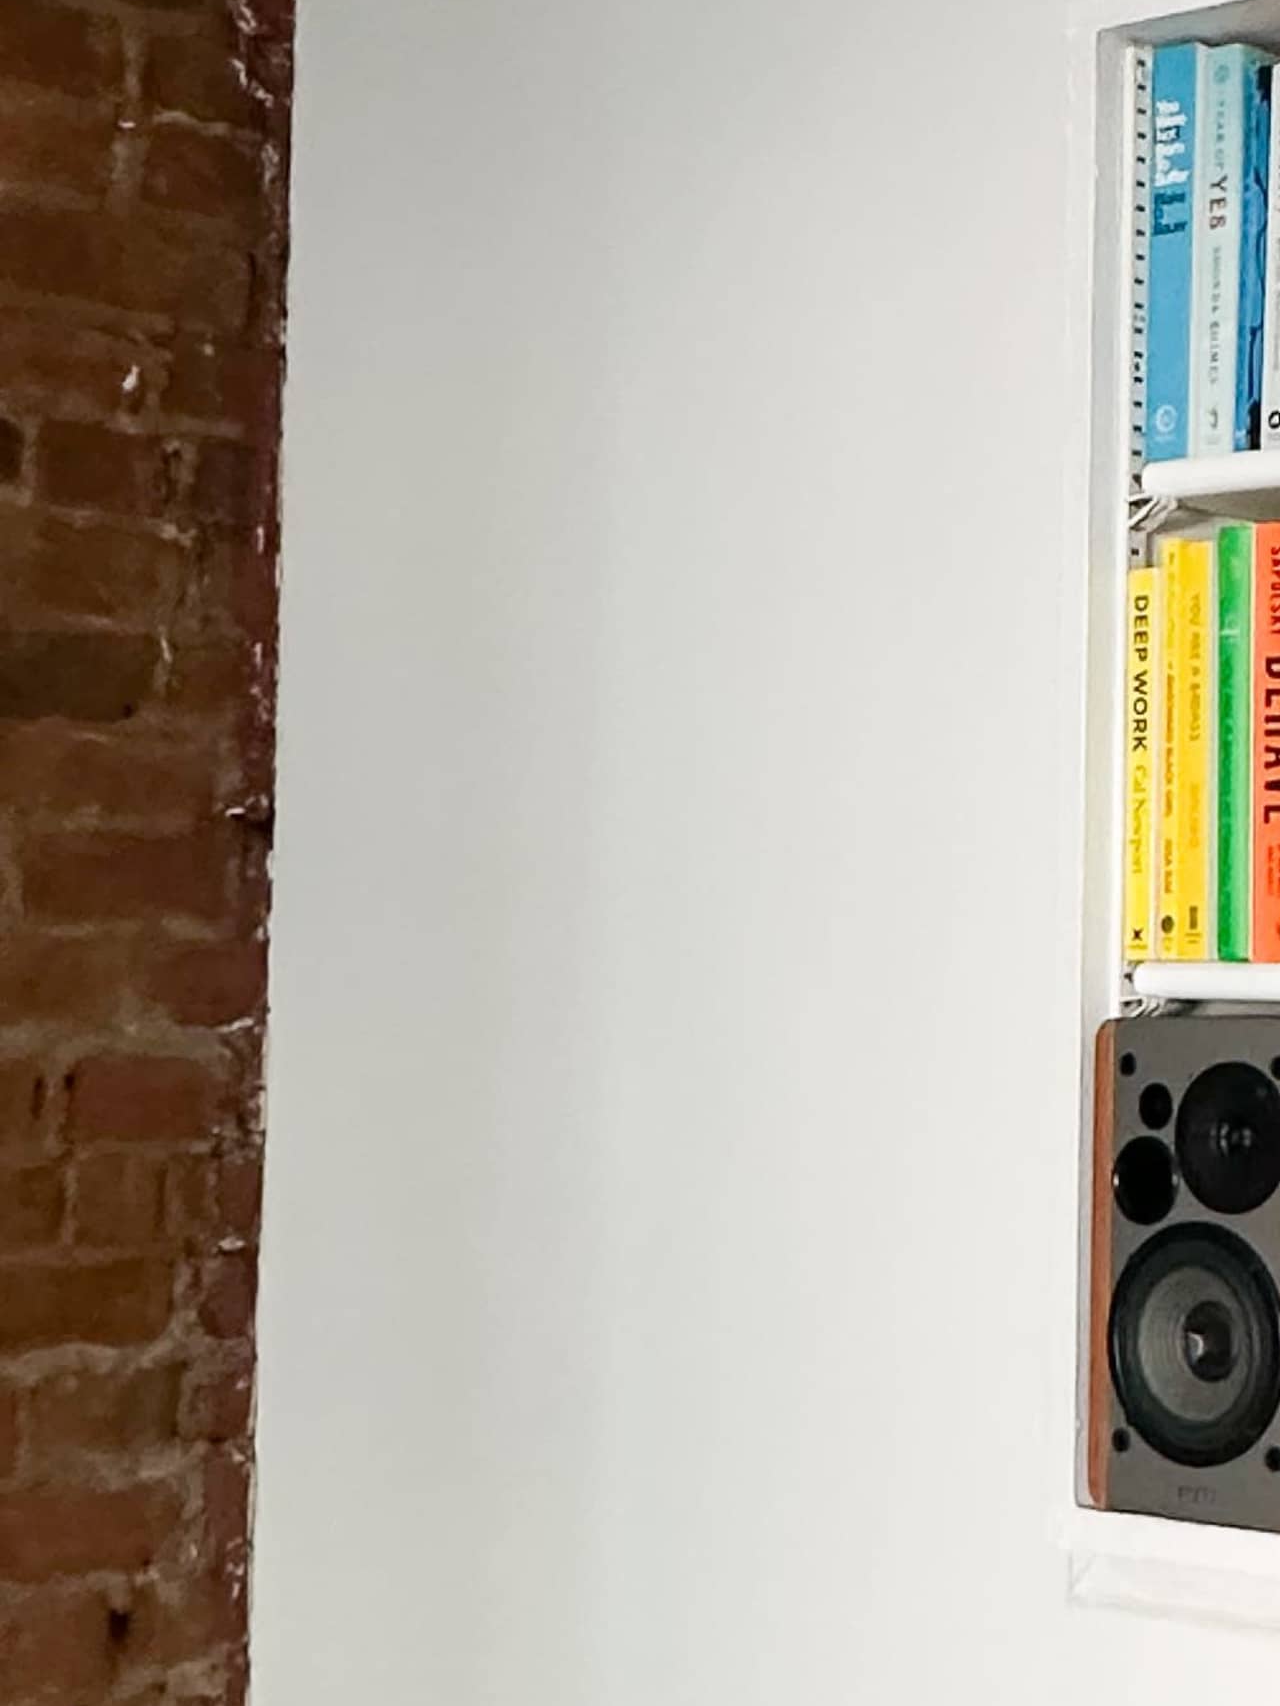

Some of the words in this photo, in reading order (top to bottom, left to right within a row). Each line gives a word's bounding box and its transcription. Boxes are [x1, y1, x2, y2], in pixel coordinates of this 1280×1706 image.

[1208, 176, 1229, 230] YES
[1133, 594, 1149, 661] DEEP
[1132, 670, 1149, 752] WORK
